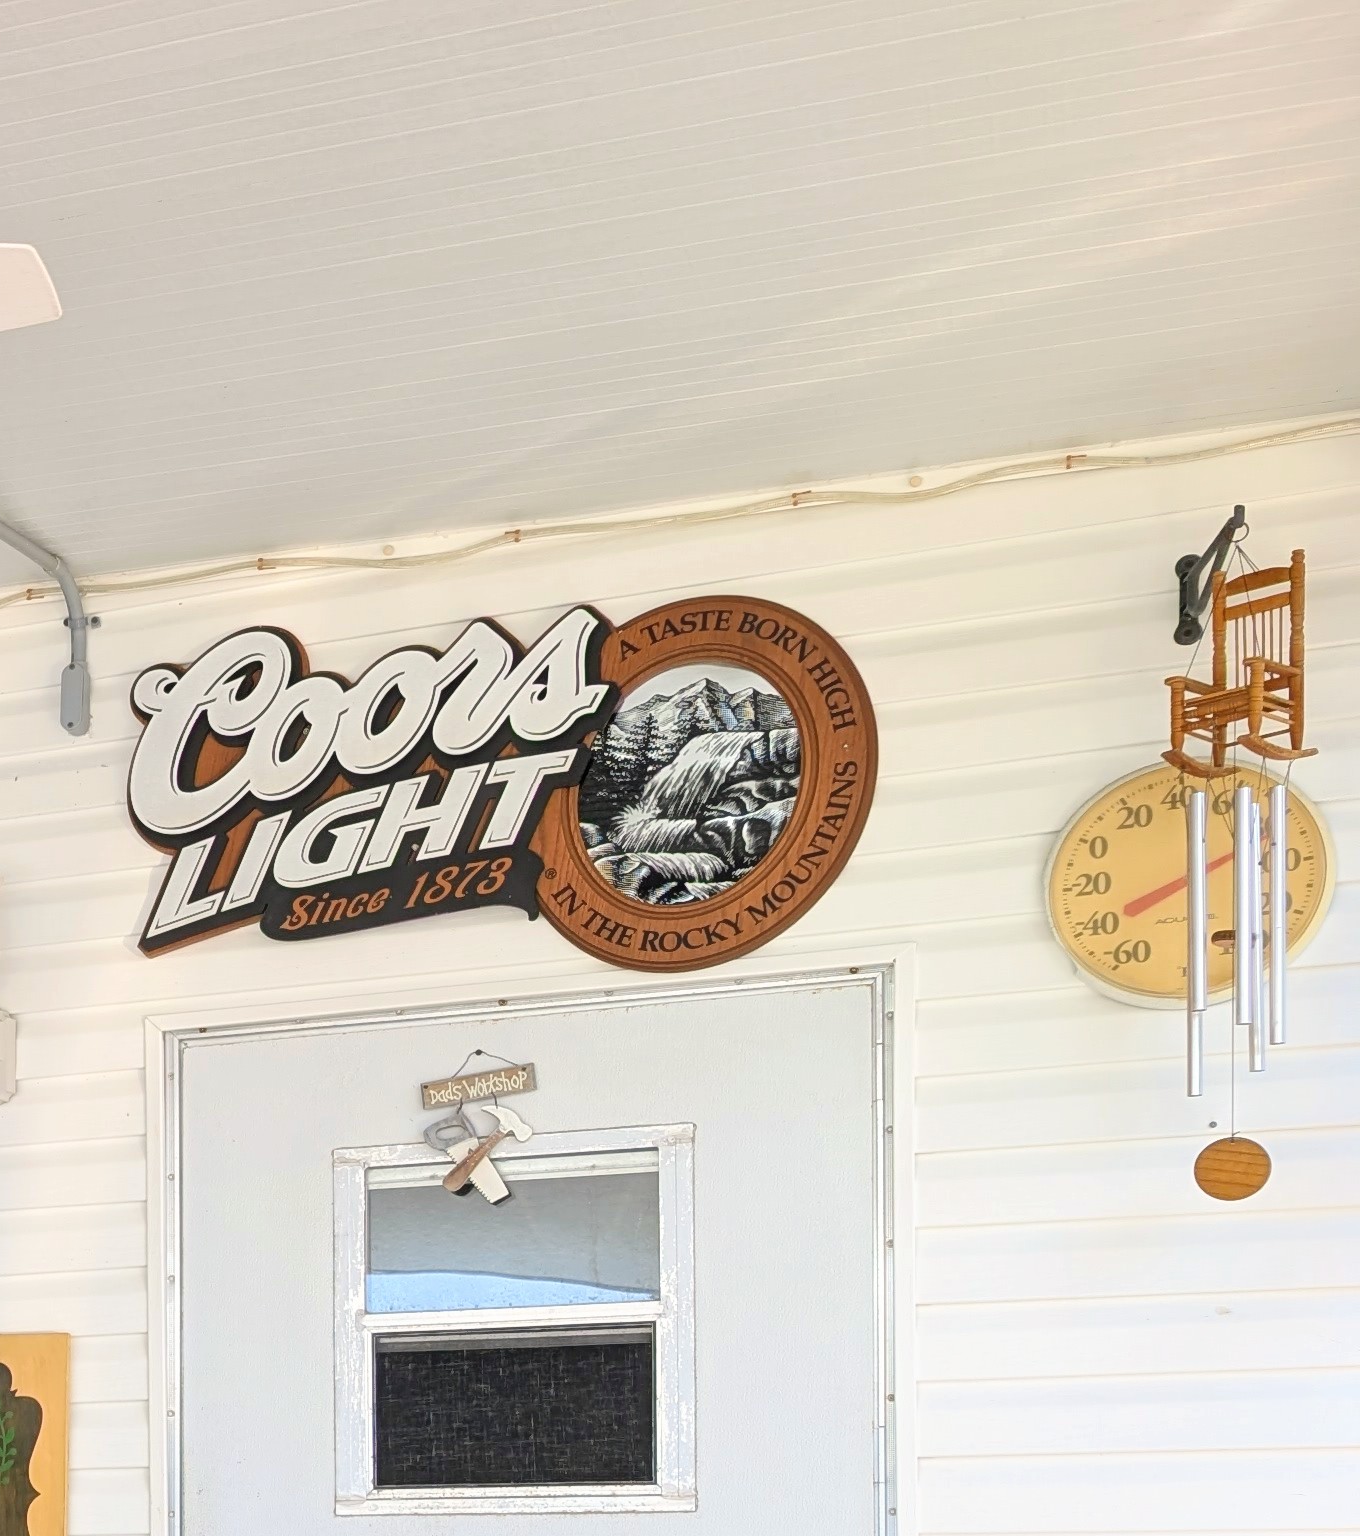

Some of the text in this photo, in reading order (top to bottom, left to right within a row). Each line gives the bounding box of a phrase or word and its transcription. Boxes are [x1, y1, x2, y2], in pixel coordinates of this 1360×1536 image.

[616, 609, 858, 734] A TASTE BORN HIGH
[129, 609, 609, 835] Coors
[145, 748, 579, 939] LIGHT
[550, 759, 858, 953] IN THE ROCKY MOUNTAINS
[1088, 835, 1109, 860] 0
[1116, 804, 1154, 830] 20
[280, 857, 513, 931] Since 1873
[1103, 939, 1152, 965] -60
